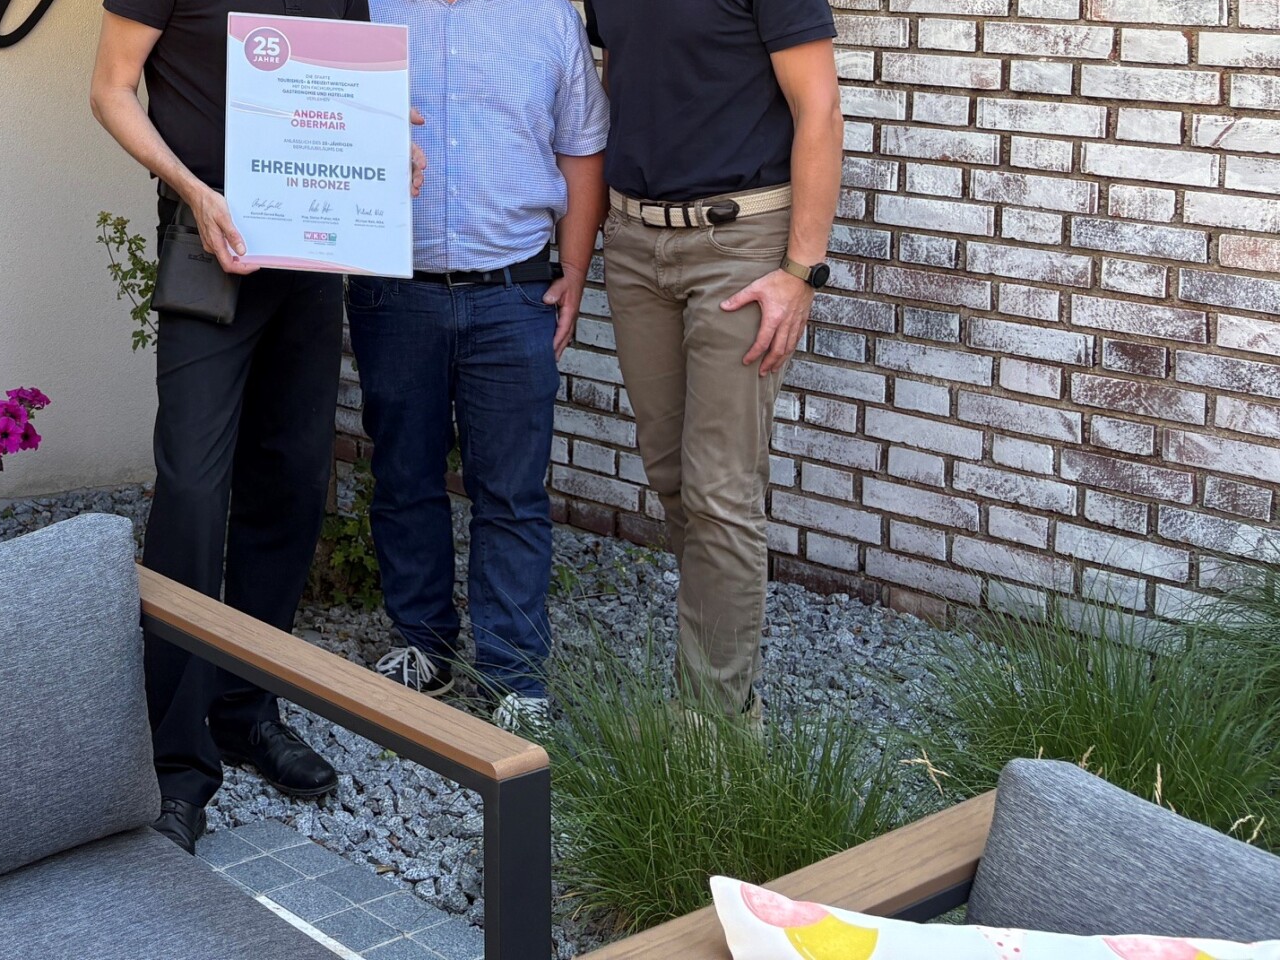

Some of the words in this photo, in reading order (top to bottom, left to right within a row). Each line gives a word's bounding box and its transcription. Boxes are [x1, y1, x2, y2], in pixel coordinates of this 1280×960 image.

[253, 36, 280, 56] 25
[253, 55, 280, 64] JAHRE
[293, 109, 344, 121] ANDREAS
[290, 118, 346, 131] OBERMAIR
[251, 159, 386, 181] EHRENURKUNDE
[286, 177, 299, 187] IN
[302, 178, 351, 191] BRONZE
[304, 231, 327, 241] WKO
